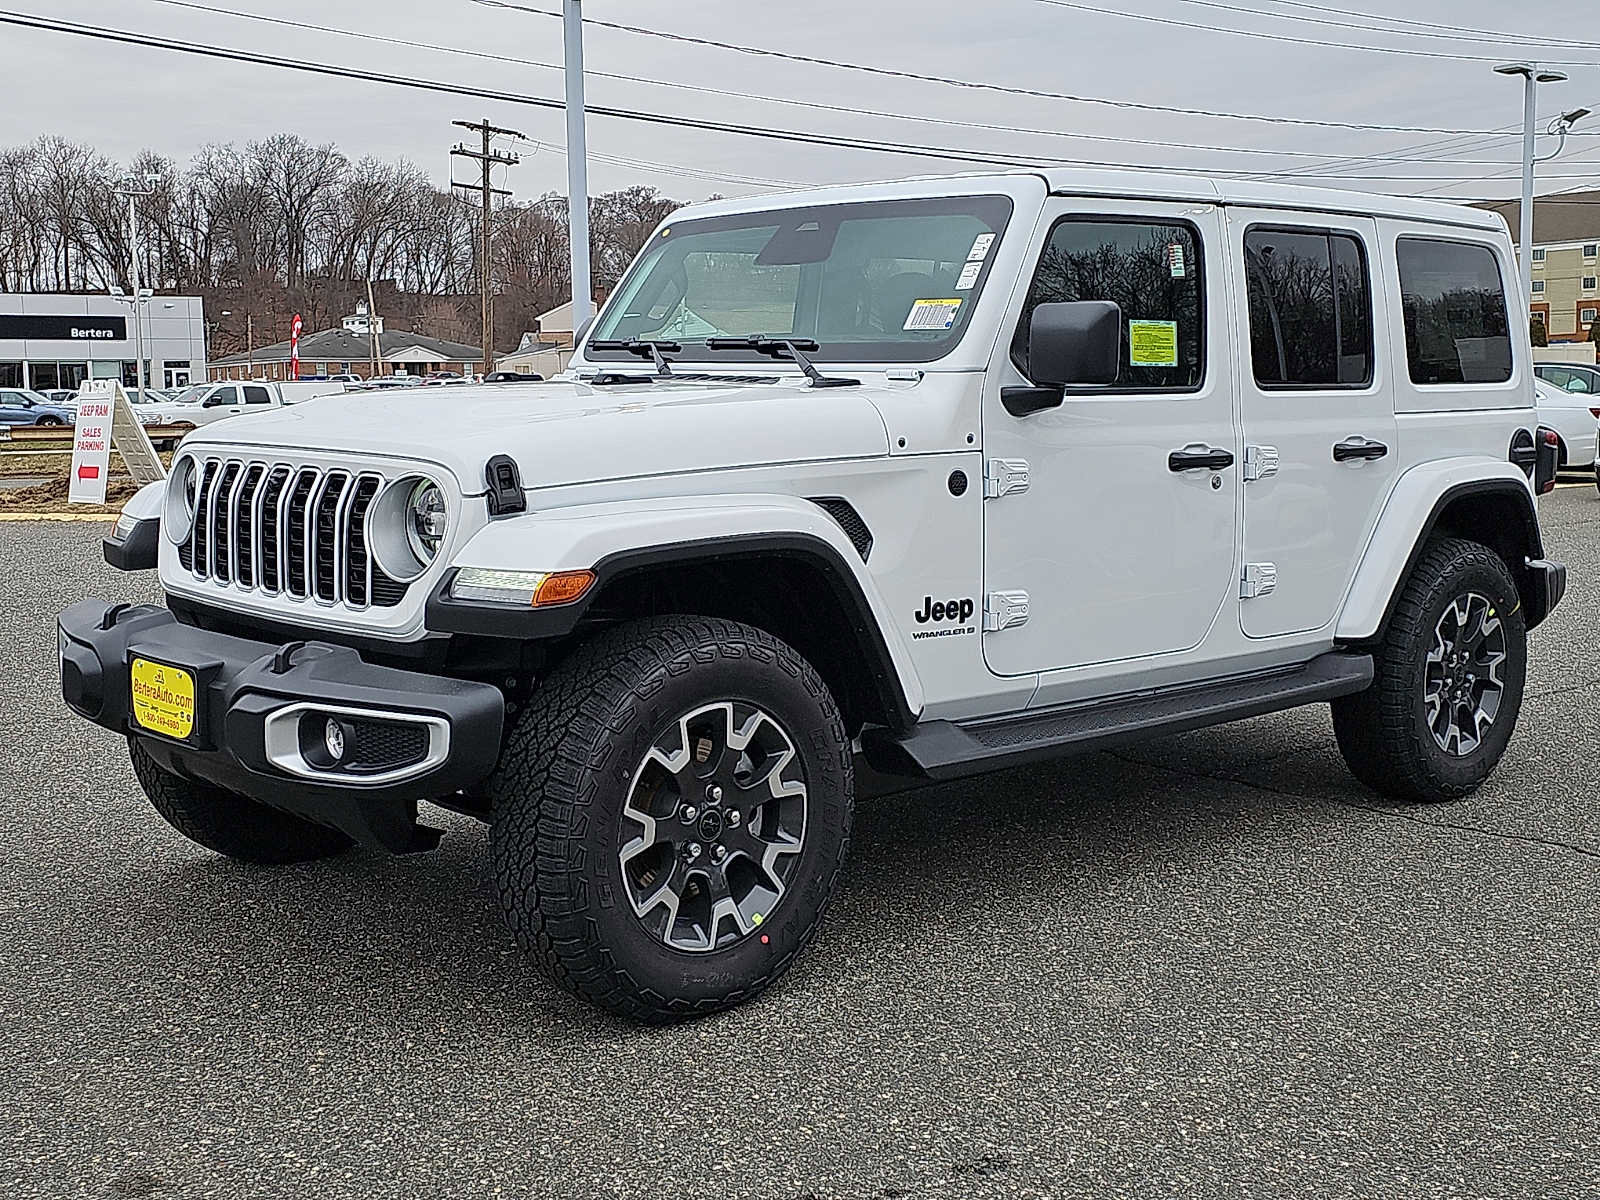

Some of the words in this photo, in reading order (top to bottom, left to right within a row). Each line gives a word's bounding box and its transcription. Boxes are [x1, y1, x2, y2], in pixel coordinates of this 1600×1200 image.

[71, 327, 114, 338] Bertera
[80, 404, 95, 417] JEEP
[95, 404, 109, 417] RAM
[82, 427, 102, 438] SALES
[77, 440, 105, 451] PARKING
[914, 596, 974, 624] Jeep
[912, 628, 966, 640] WRANGLER
[134, 677, 193, 710] BerteraAuto.com
